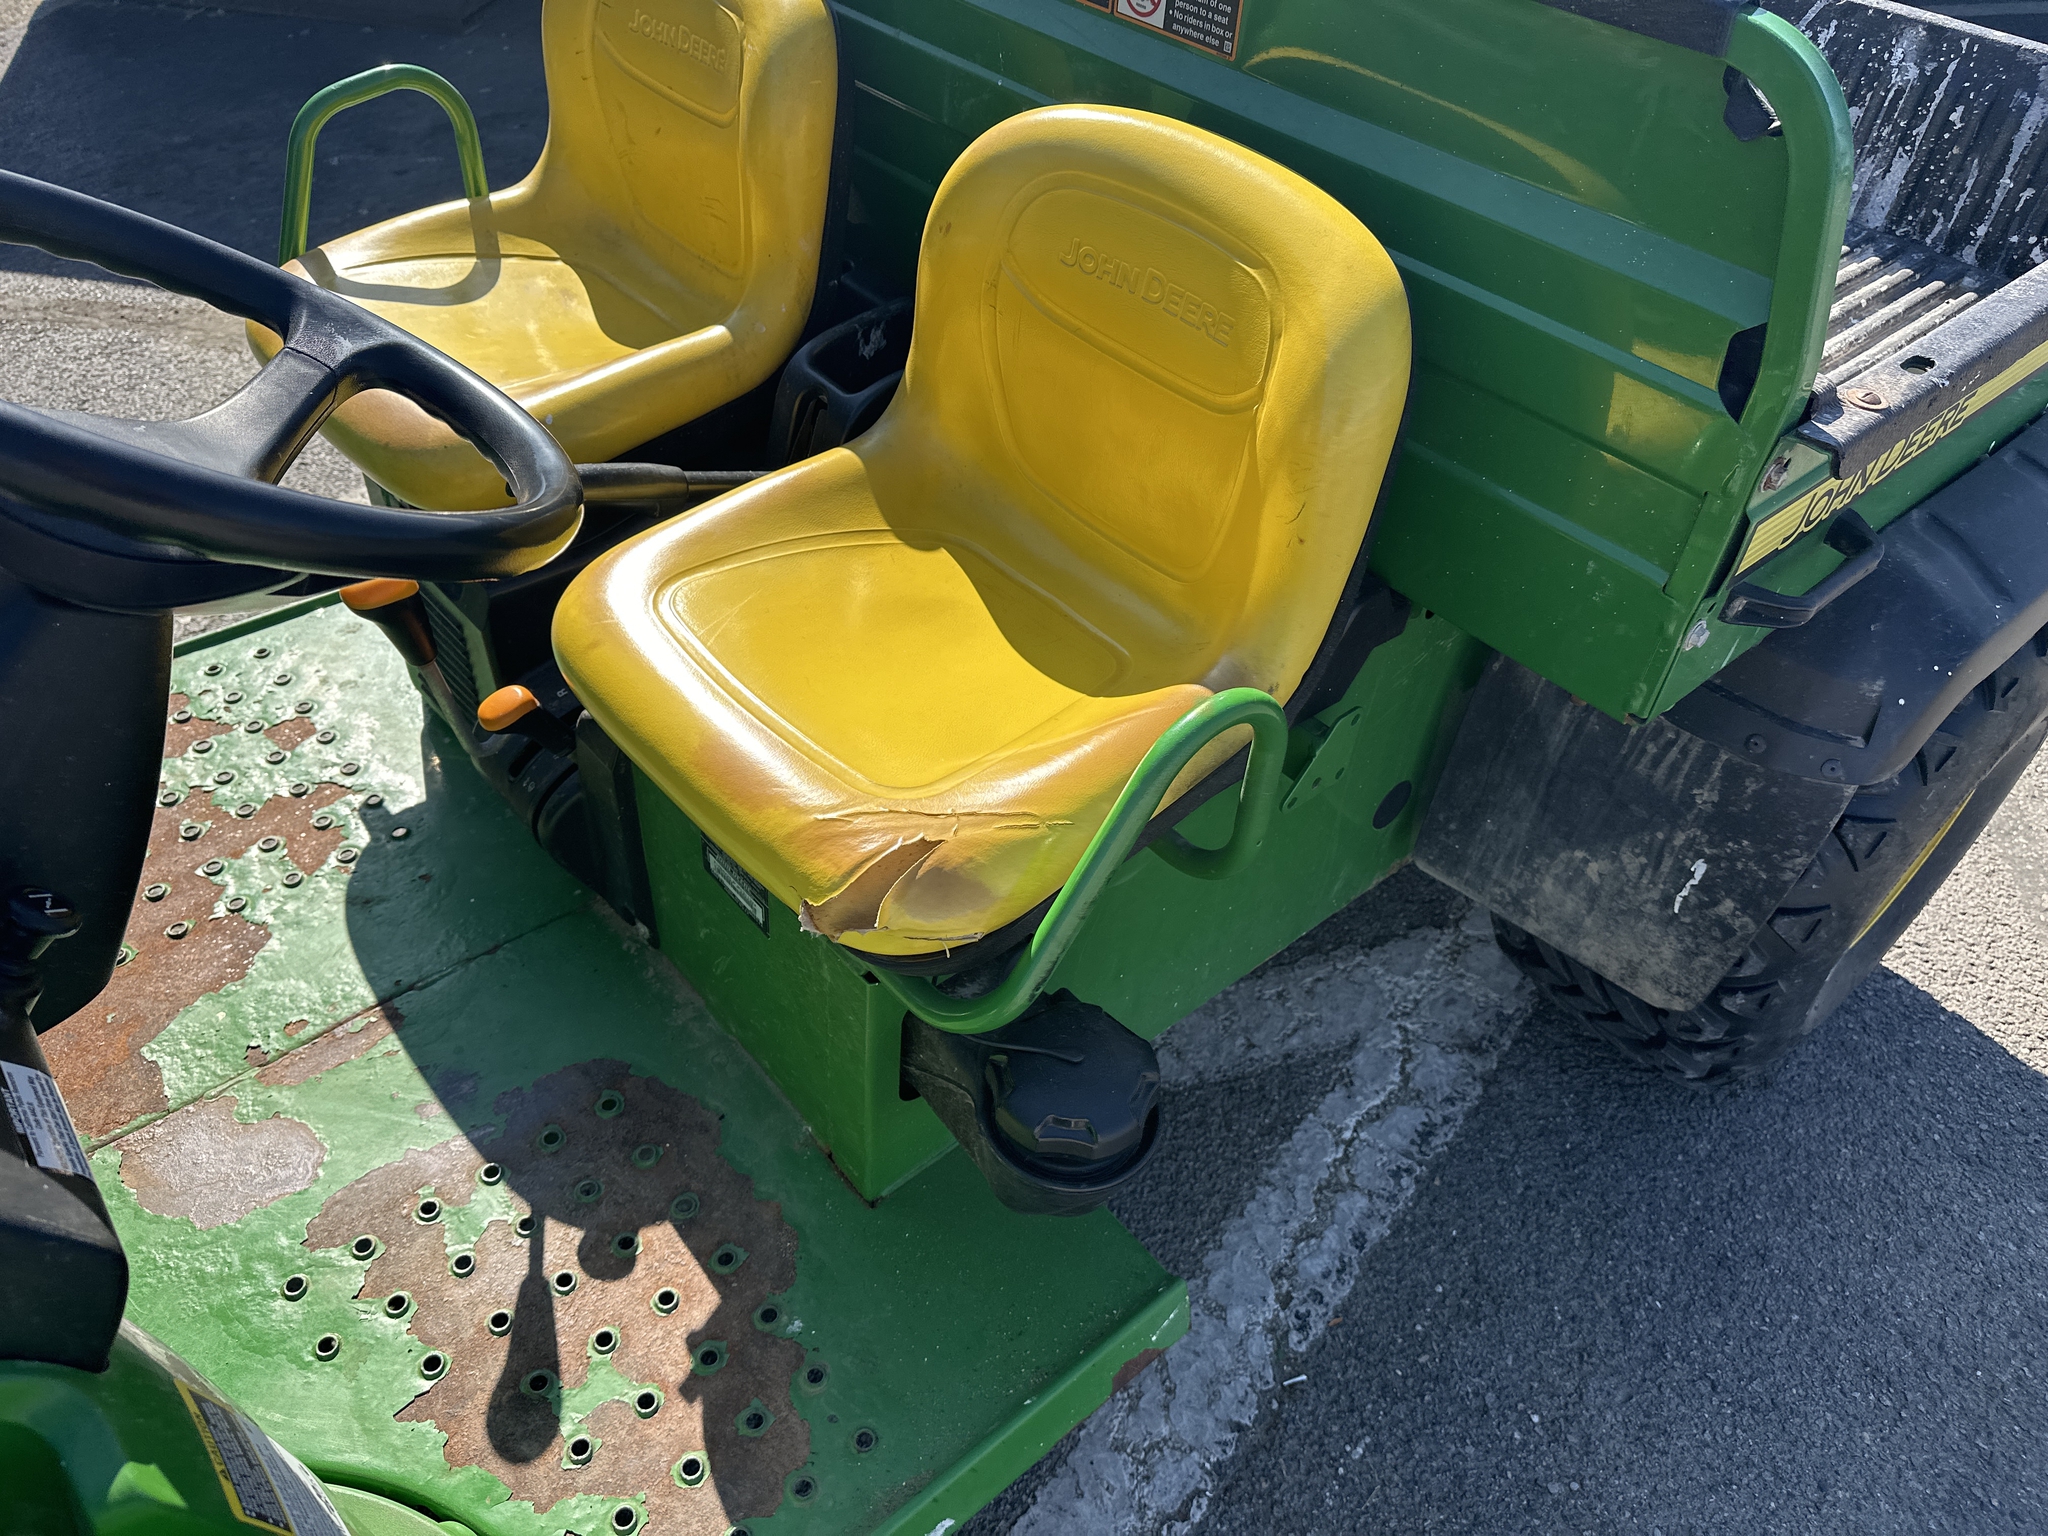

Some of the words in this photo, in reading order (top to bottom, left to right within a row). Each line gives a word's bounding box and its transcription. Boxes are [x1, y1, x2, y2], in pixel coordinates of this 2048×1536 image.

[1175, 0, 1198, 14] person
[1199, 7, 1207, 17] to
[1207, 11, 1213, 19] a
[1213, 15, 1229, 25] seat
[1210, 0, 1217, 8] of
[1218, 3, 1232, 14] one
[1172, 23, 1205, 41] anywhere
[1205, 35, 1220, 47] else
[1173, 9, 1183, 20] No
[1183, 14, 1203, 28] riders
[1203, 20, 1211, 31] in
[1211, 25, 1225, 36] box
[1224, 31, 1233, 39] or
[628, 9, 677, 48] JOHN
[678, 24, 727, 74] DEERE
[1059, 237, 1141, 295] JOHN
[1141, 267, 1236, 348] DEERE
[1778, 457, 1882, 550] JOHN
[1871, 388, 1979, 486] DEERE
